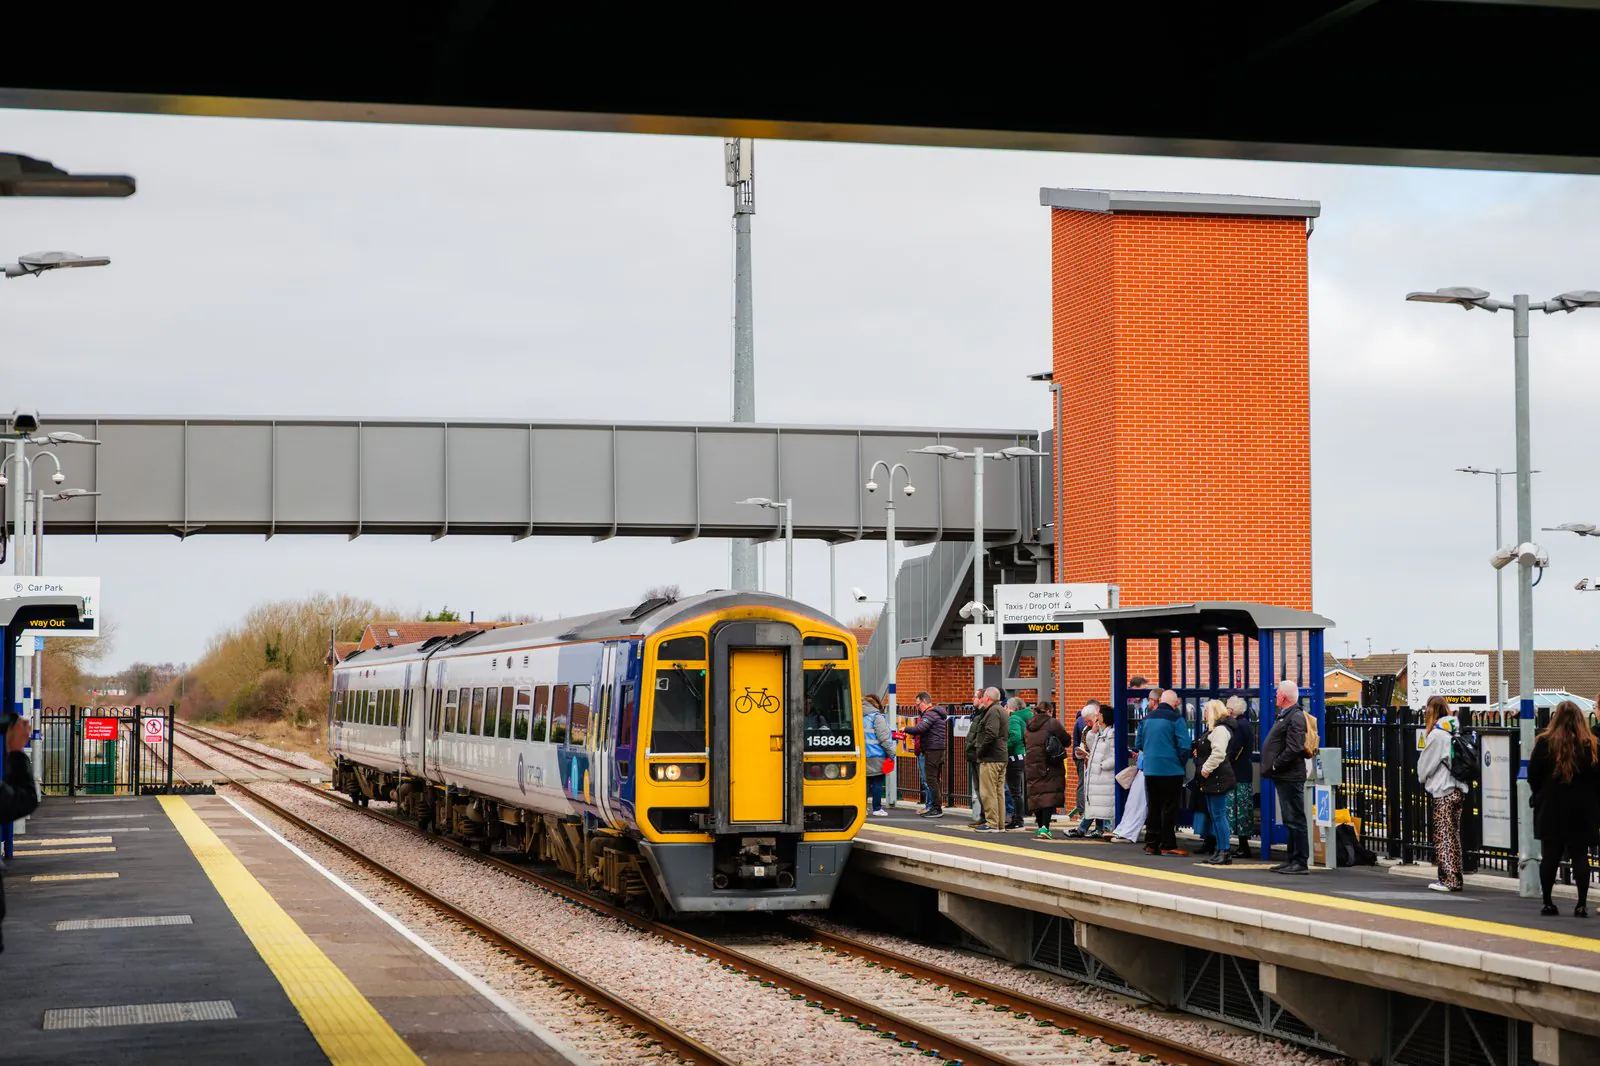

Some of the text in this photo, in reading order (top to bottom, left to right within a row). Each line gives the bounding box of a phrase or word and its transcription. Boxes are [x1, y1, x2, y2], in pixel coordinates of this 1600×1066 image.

[1030, 603, 1047, 611] Drop
[1028, 624, 1044, 632] Way
[977, 632, 983, 646] 1
[807, 736, 851, 746] 158843
